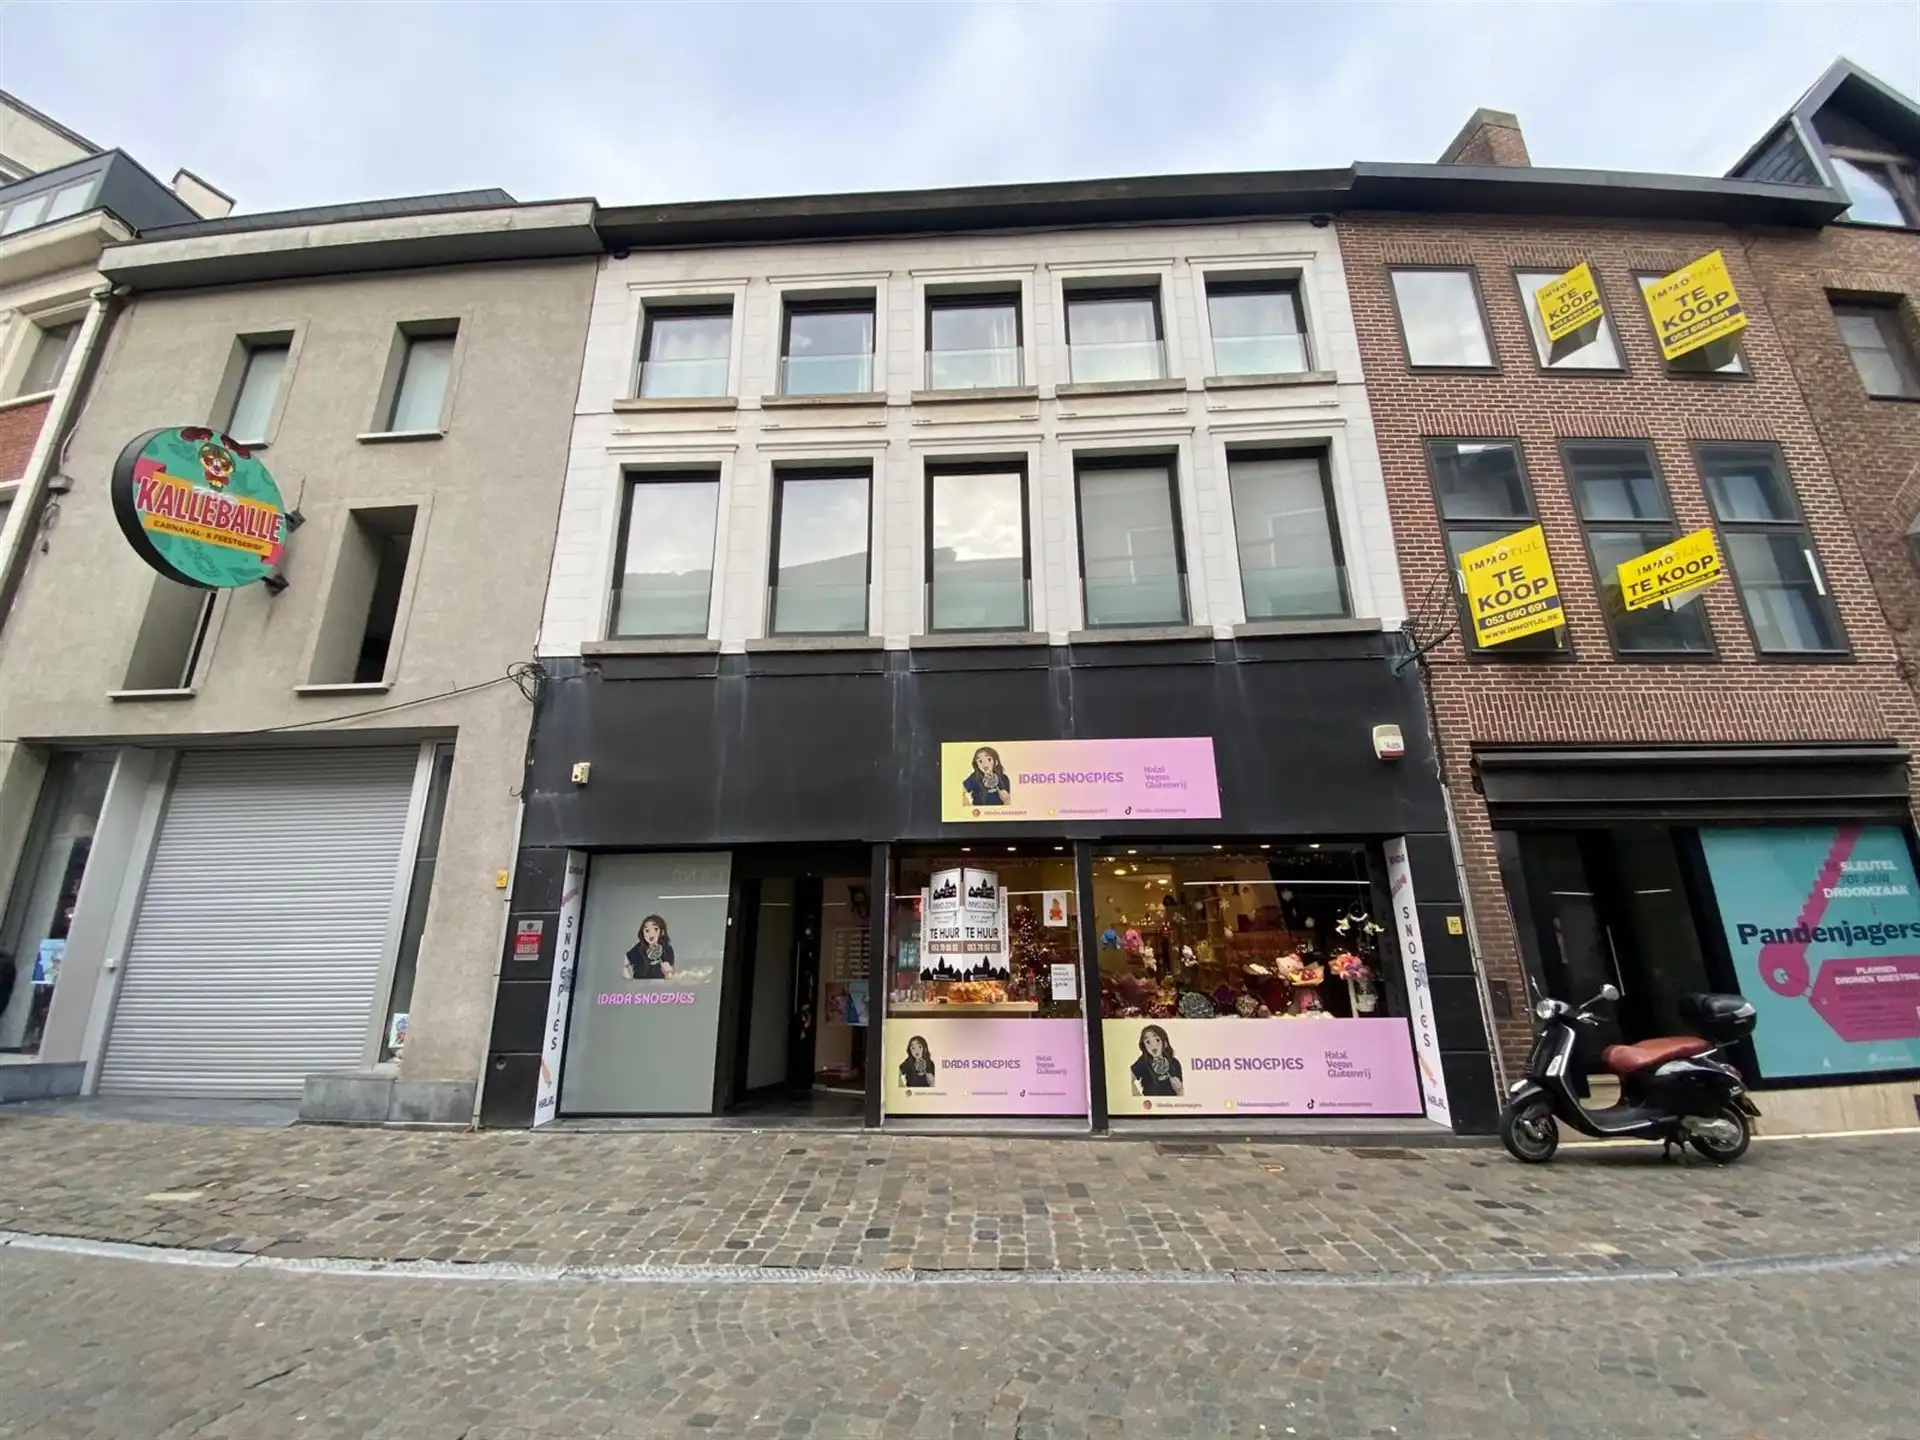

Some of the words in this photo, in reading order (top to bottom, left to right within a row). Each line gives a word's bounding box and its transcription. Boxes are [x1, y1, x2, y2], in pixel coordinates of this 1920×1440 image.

[1557, 288, 1578, 303] TE
[1675, 286, 1708, 307] TE
[1549, 290, 1593, 320] KOOP
[1662, 291, 1729, 331] KOOP
[135, 475, 284, 543] KALLEBALLE
[1492, 565, 1526, 587] TE
[1628, 578, 1653, 596] TE
[1657, 555, 1714, 587] KOOP
[1478, 577, 1549, 612] KOOP
[1485, 613, 1506, 626] 052
[1506, 607, 1527, 620] 690
[1527, 601, 1548, 613] 691
[1018, 772, 1055, 784] IDADA
[930, 928, 938, 939] TE
[940, 927, 960, 939] HUUR
[965, 927, 975, 939] TE
[977, 927, 999, 939] HUUR
[1736, 919, 1920, 947] Pandenjagers
[597, 992, 632, 1005] IDADA
[1325, 1050, 1348, 1059] Halal
[941, 1059, 970, 1069] IDADA
[1191, 1058, 1231, 1070] IDADA
[1326, 1060, 1353, 1070] Vegan
